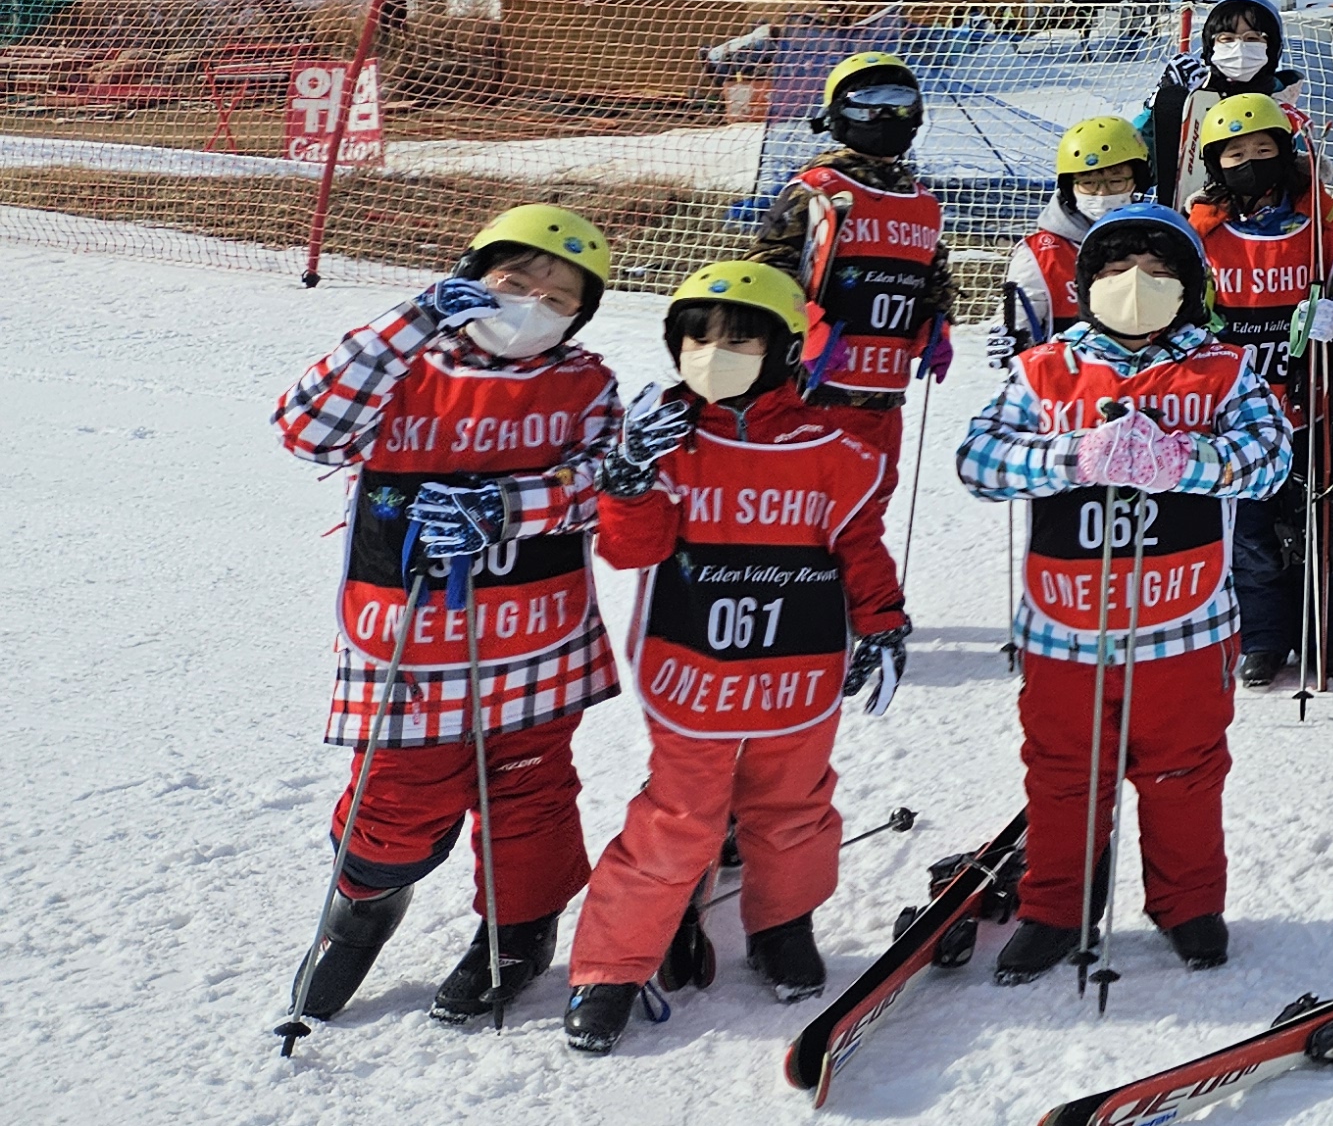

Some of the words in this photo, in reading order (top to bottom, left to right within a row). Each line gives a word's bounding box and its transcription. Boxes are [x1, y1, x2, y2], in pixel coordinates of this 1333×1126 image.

[840, 219, 880, 243] SKI
[864, 270, 896, 284] Eden
[1251, 265, 1308, 294] SCHO
[869, 293, 916, 331] 071
[1232, 321, 1262, 334] Eden
[1262, 320, 1291, 334] Valle
[1038, 398, 1085, 434] SKI
[386, 416, 439, 453] SKI
[683, 488, 722, 524] KI
[1078, 499, 1159, 550] 062
[698, 565, 743, 584] Eden
[743, 566, 794, 588] Valley
[707, 595, 784, 651] 061
[650, 658, 827, 714] ONEEIGHT
